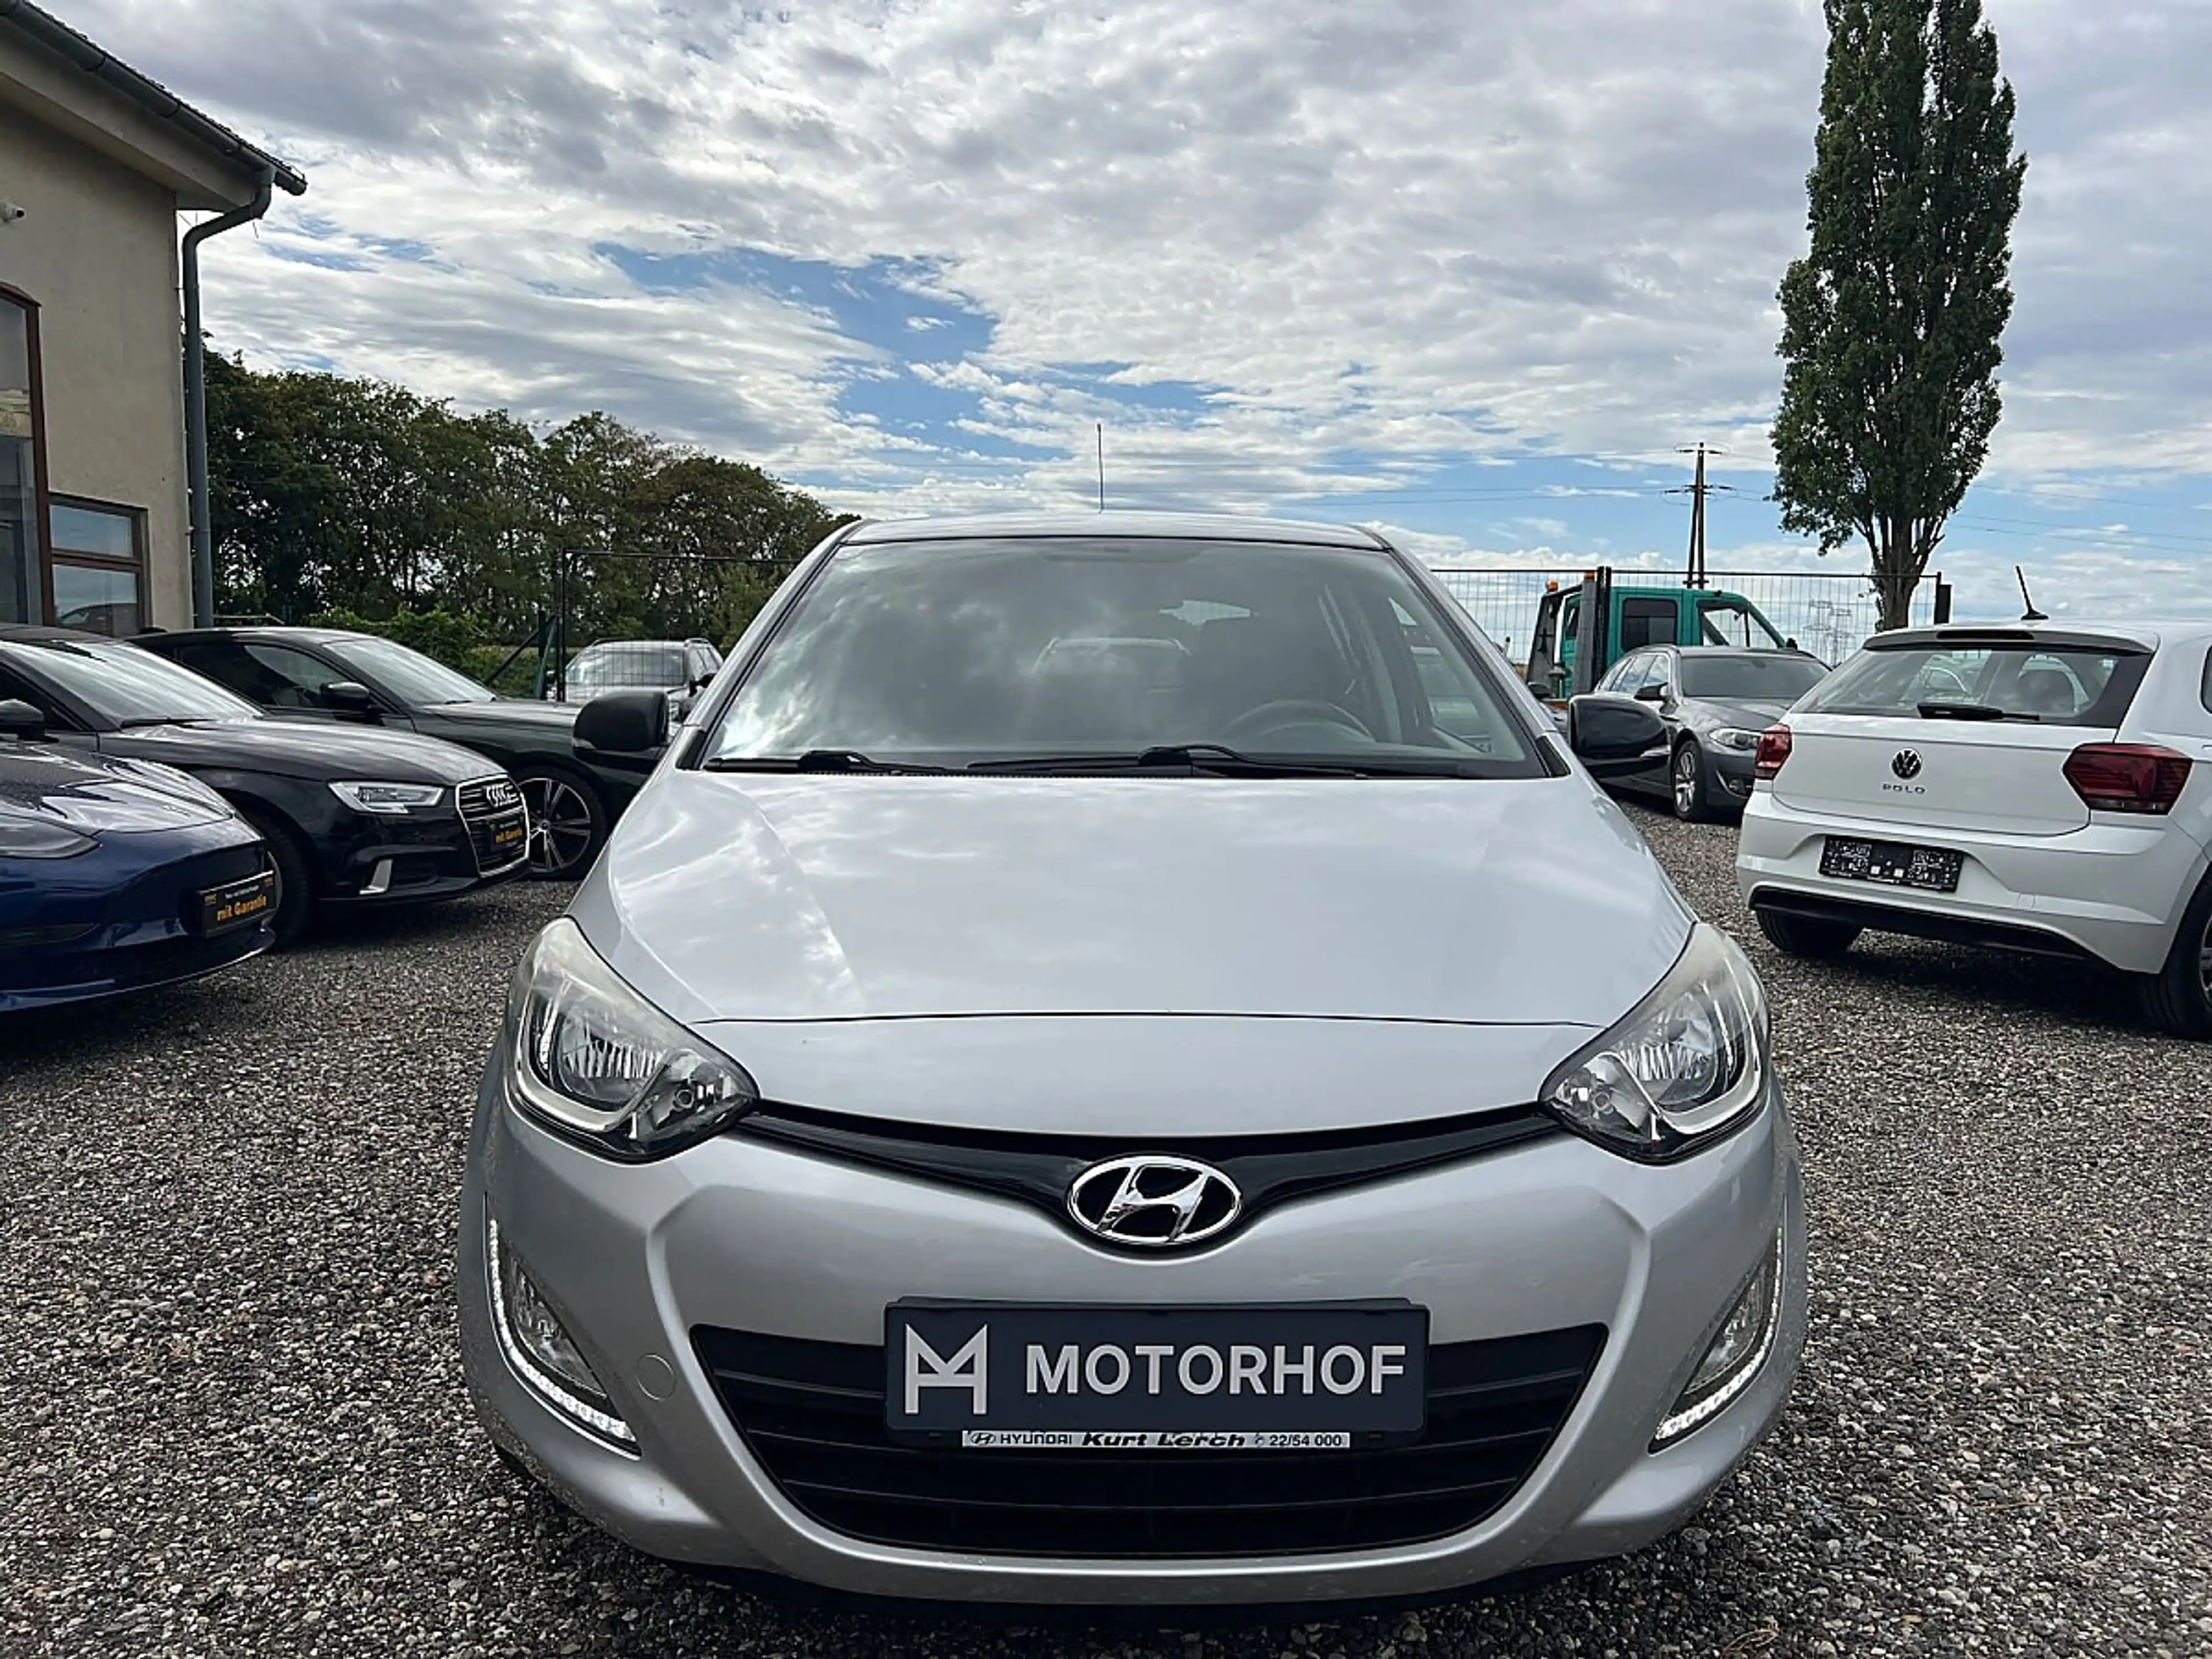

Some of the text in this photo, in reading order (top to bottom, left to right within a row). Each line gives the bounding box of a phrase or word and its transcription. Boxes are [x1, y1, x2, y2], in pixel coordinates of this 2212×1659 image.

[1882, 783, 1926, 794] POLO
[1025, 1344, 1407, 1395] MOTORHOF
[1000, 1433, 1073, 1445] HYUNDAI
[1081, 1432, 1149, 1446] Kurt
[1157, 1433, 1247, 1446] Lerch
[1314, 1433, 1342, 1446] 000
